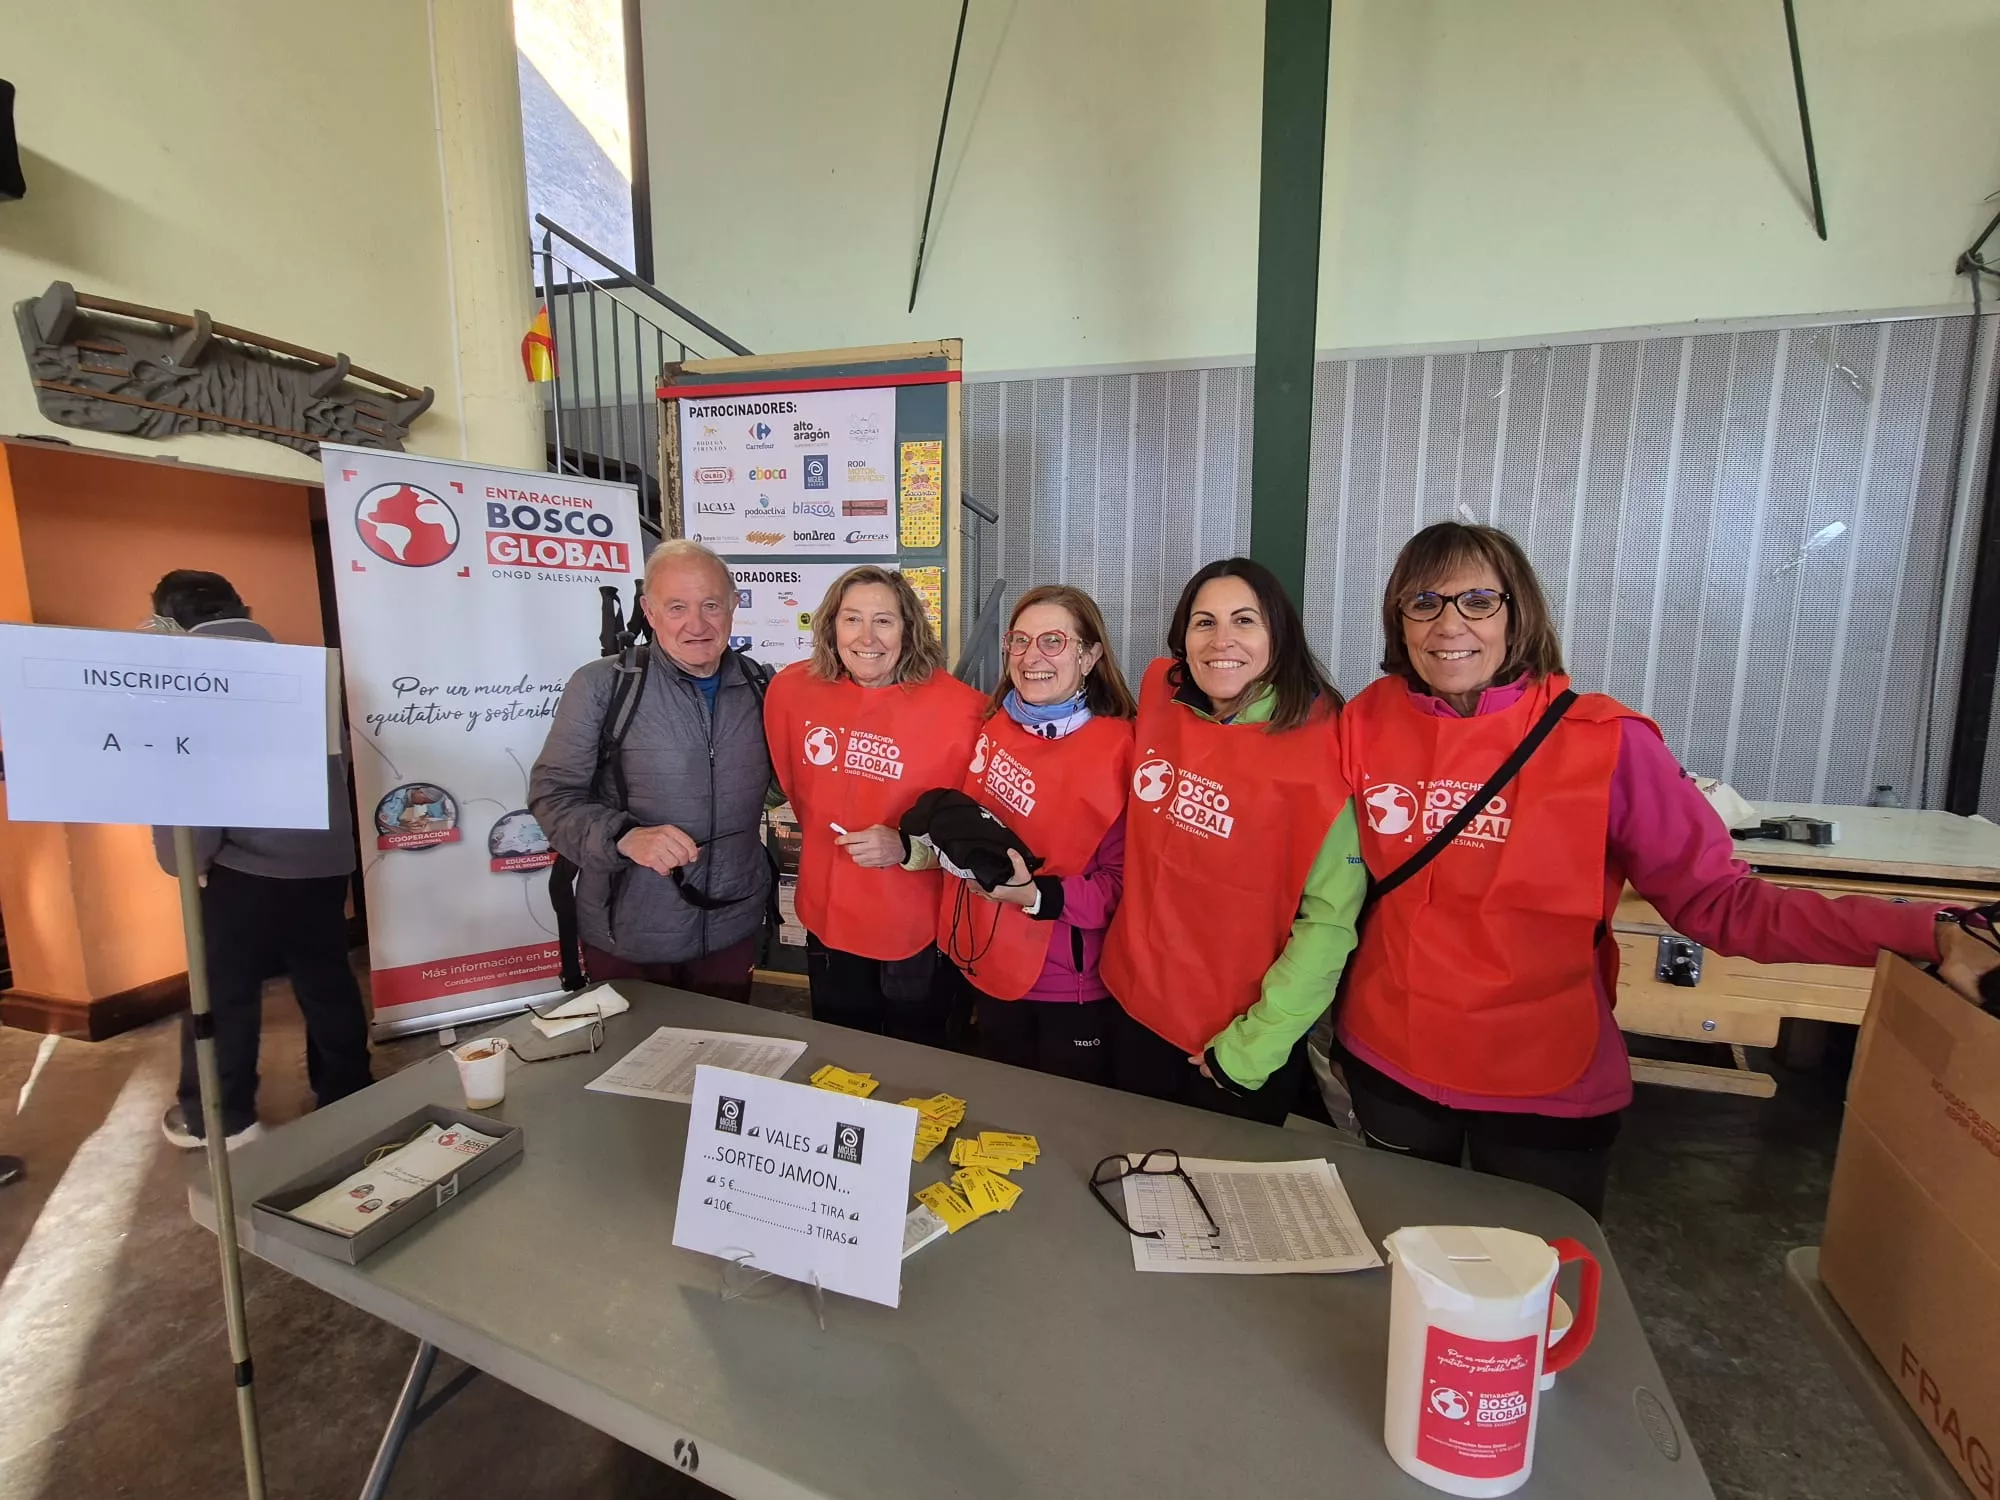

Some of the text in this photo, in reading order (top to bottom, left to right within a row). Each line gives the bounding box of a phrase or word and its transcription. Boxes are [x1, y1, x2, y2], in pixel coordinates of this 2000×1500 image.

[689, 401, 797, 418] PATROCINADORES:
[793, 420, 813, 431] alto
[793, 429, 830, 442] aragón
[847, 460, 866, 468] RODI
[749, 467, 787, 481] eboca
[485, 486, 593, 509] ENTARACHEN
[697, 502, 735, 514] LACASA
[744, 507, 786, 518] podoactiva
[792, 501, 830, 514] blasco
[487, 502, 613, 537] BOSCO
[845, 530, 889, 544] Correas
[490, 535, 626, 569] GLOBAL
[492, 570, 601, 584] ONGD SALESIANA
[730, 572, 801, 583] ORADORES:
[84, 667, 230, 693] INSCRIPCIÓN
[392, 674, 565, 698] Por un mundo má
[366, 697, 560, 736] equitativo y sostenibl
[103, 733, 121, 752] A
[176, 737, 191, 755] K
[851, 730, 893, 744] ENTARACHEN
[848, 737, 900, 760] BOSCO
[847, 754, 899, 776] GLOBAL
[991, 754, 1036, 794] BOSCO
[987, 771, 1029, 814] GLOBAL
[1178, 780, 1230, 812] OSCO
[1174, 798, 1227, 834] LOBAL
[388, 831, 450, 843] COOPERACIÓN
[505, 855, 550, 865] EDUCACIÓN
[422, 949, 560, 980] Más información en bo
[444, 973, 496, 988] Contáctanos
[719, 1117, 738, 1129] MIGUEL
[766, 1127, 811, 1152] VALES
[838, 1145, 857, 1157] MIGUEL
[719, 1176, 726, 1188] 5
[821, 1203, 845, 1220] TIRA
[816, 1226, 847, 1244] TIRAS
[1479, 1394, 1524, 1410] BOSCO
[1479, 1405, 1525, 1421] GLOBAL
